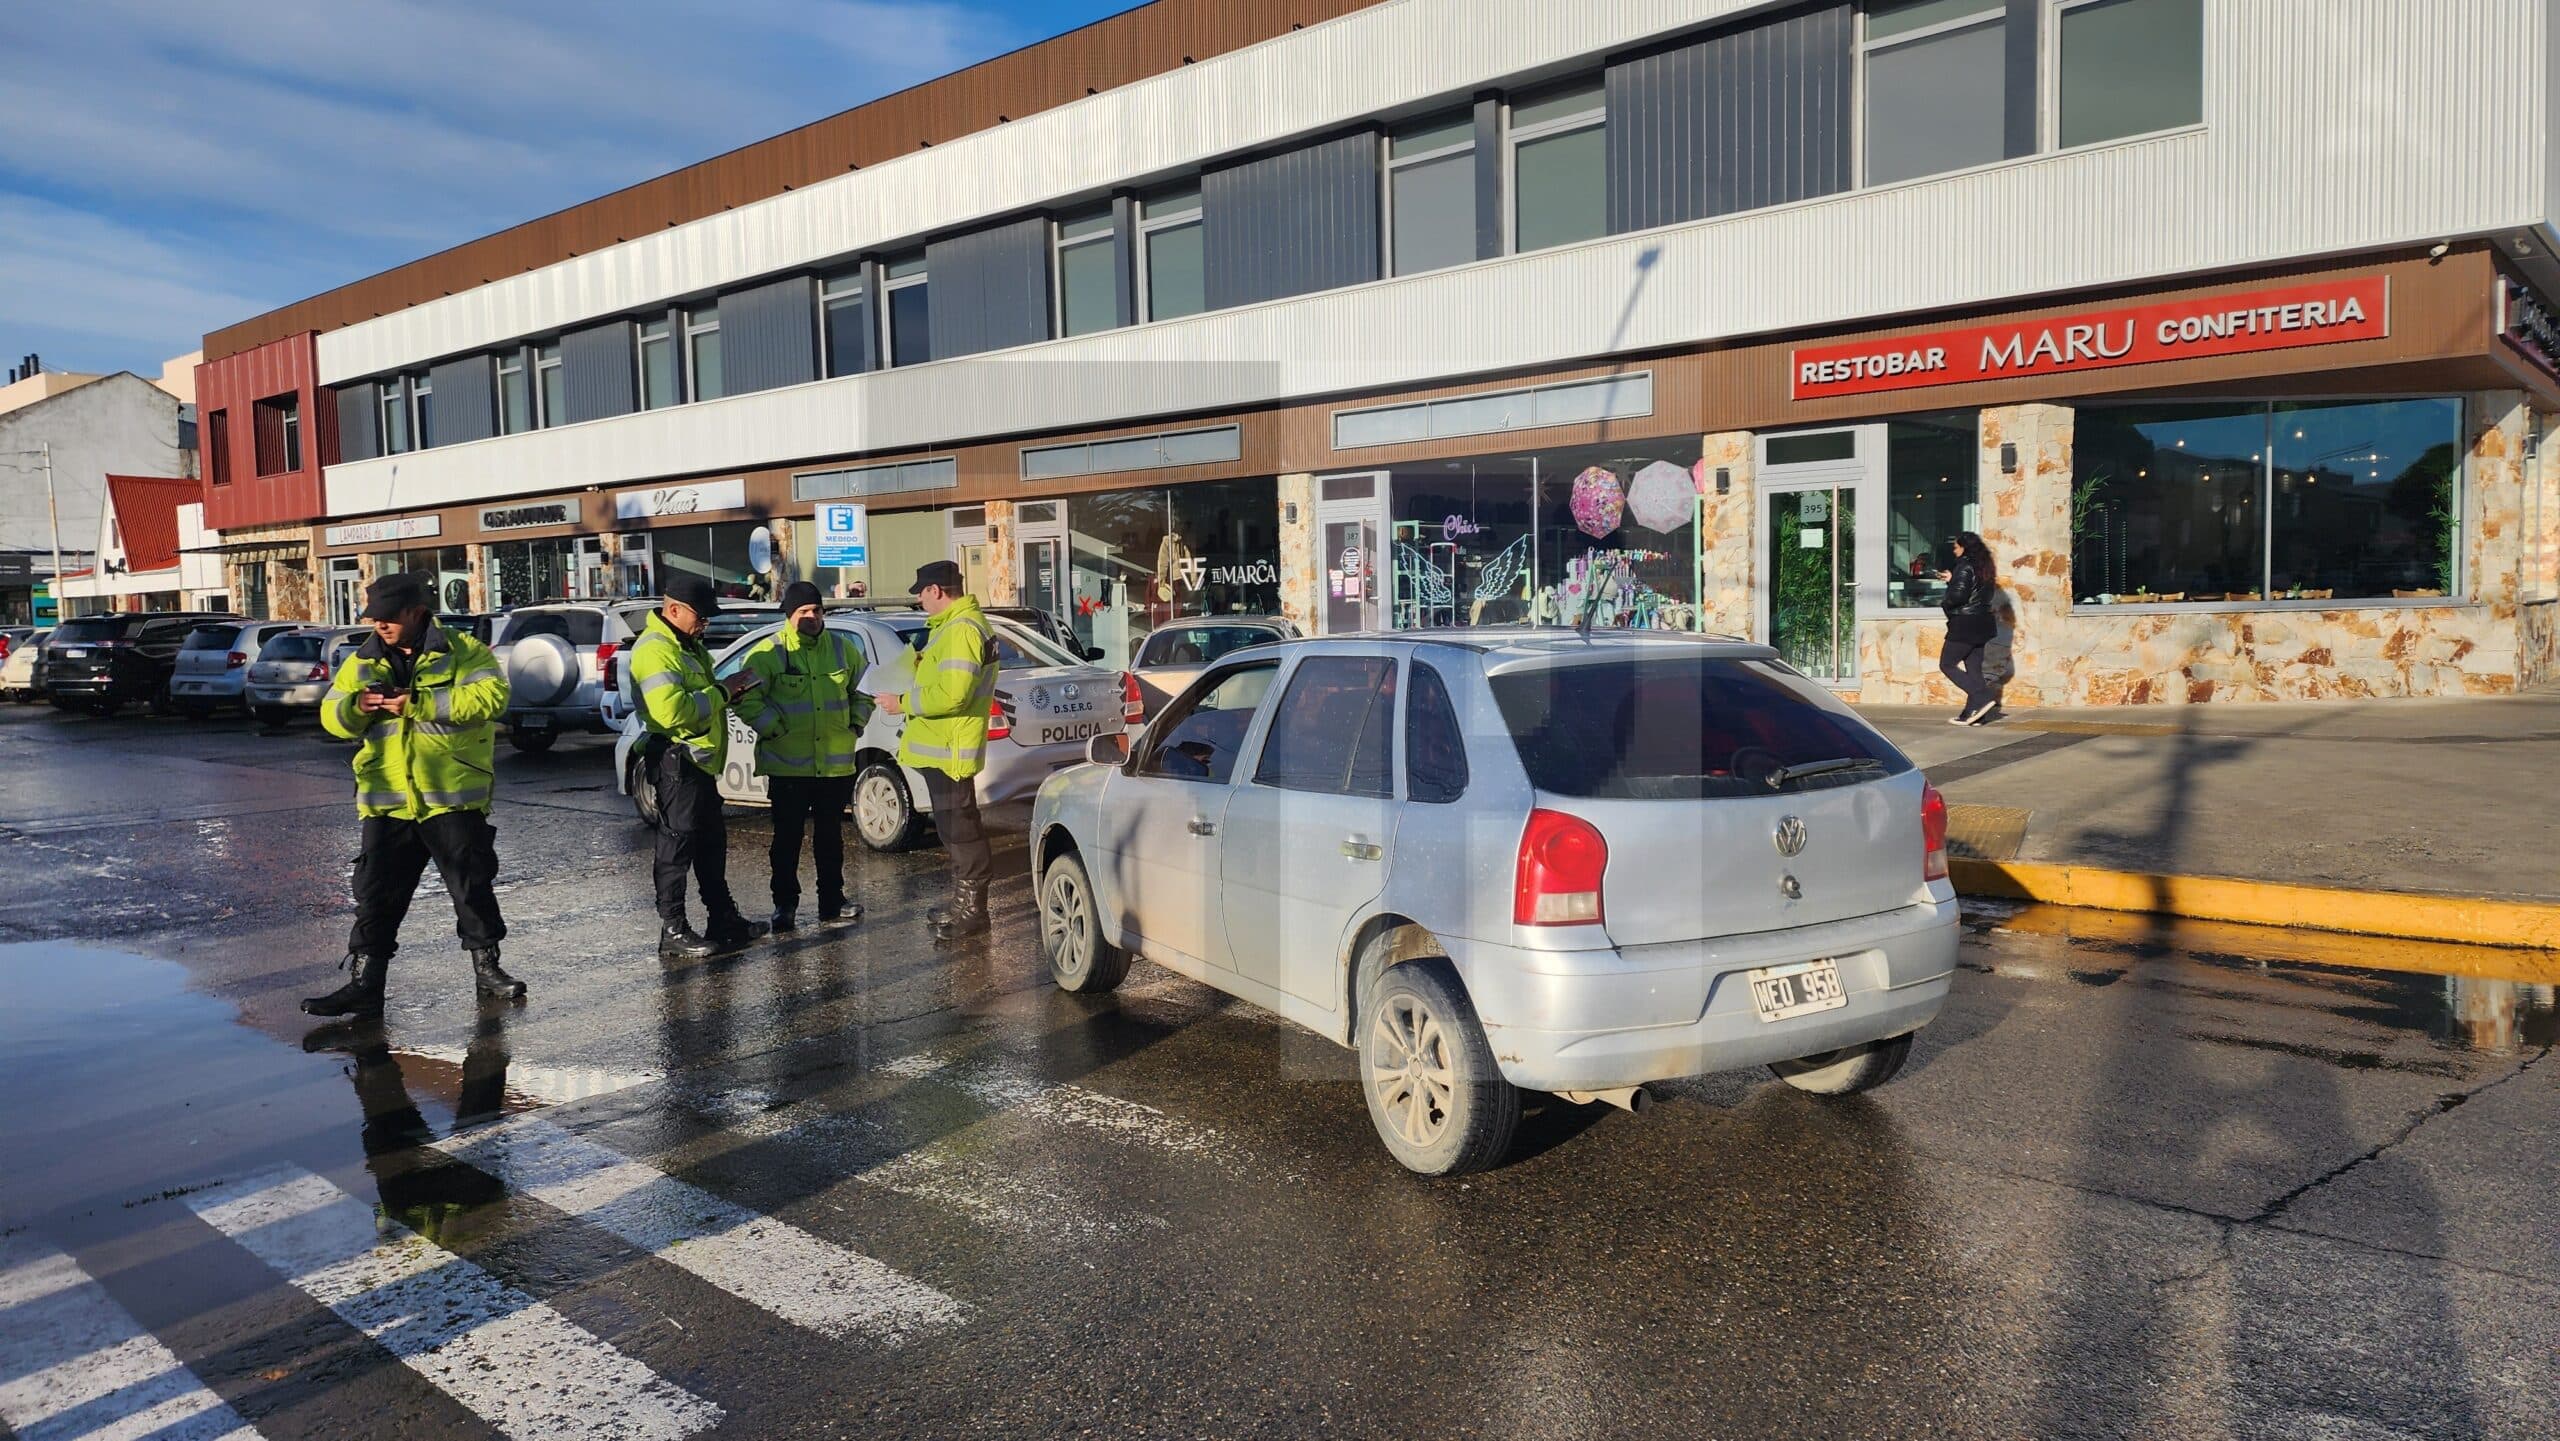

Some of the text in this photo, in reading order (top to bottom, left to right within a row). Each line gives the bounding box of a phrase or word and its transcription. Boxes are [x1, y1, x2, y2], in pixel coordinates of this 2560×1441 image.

[1800, 296, 2366, 385] RESTOBAR MARU CONFITERIA
[1804, 505, 1823, 514] 395
[1222, 564, 1277, 585] MARCA
[1054, 702, 1094, 715] D.S.E.R.G
[1042, 722, 1102, 743] POLICIA
